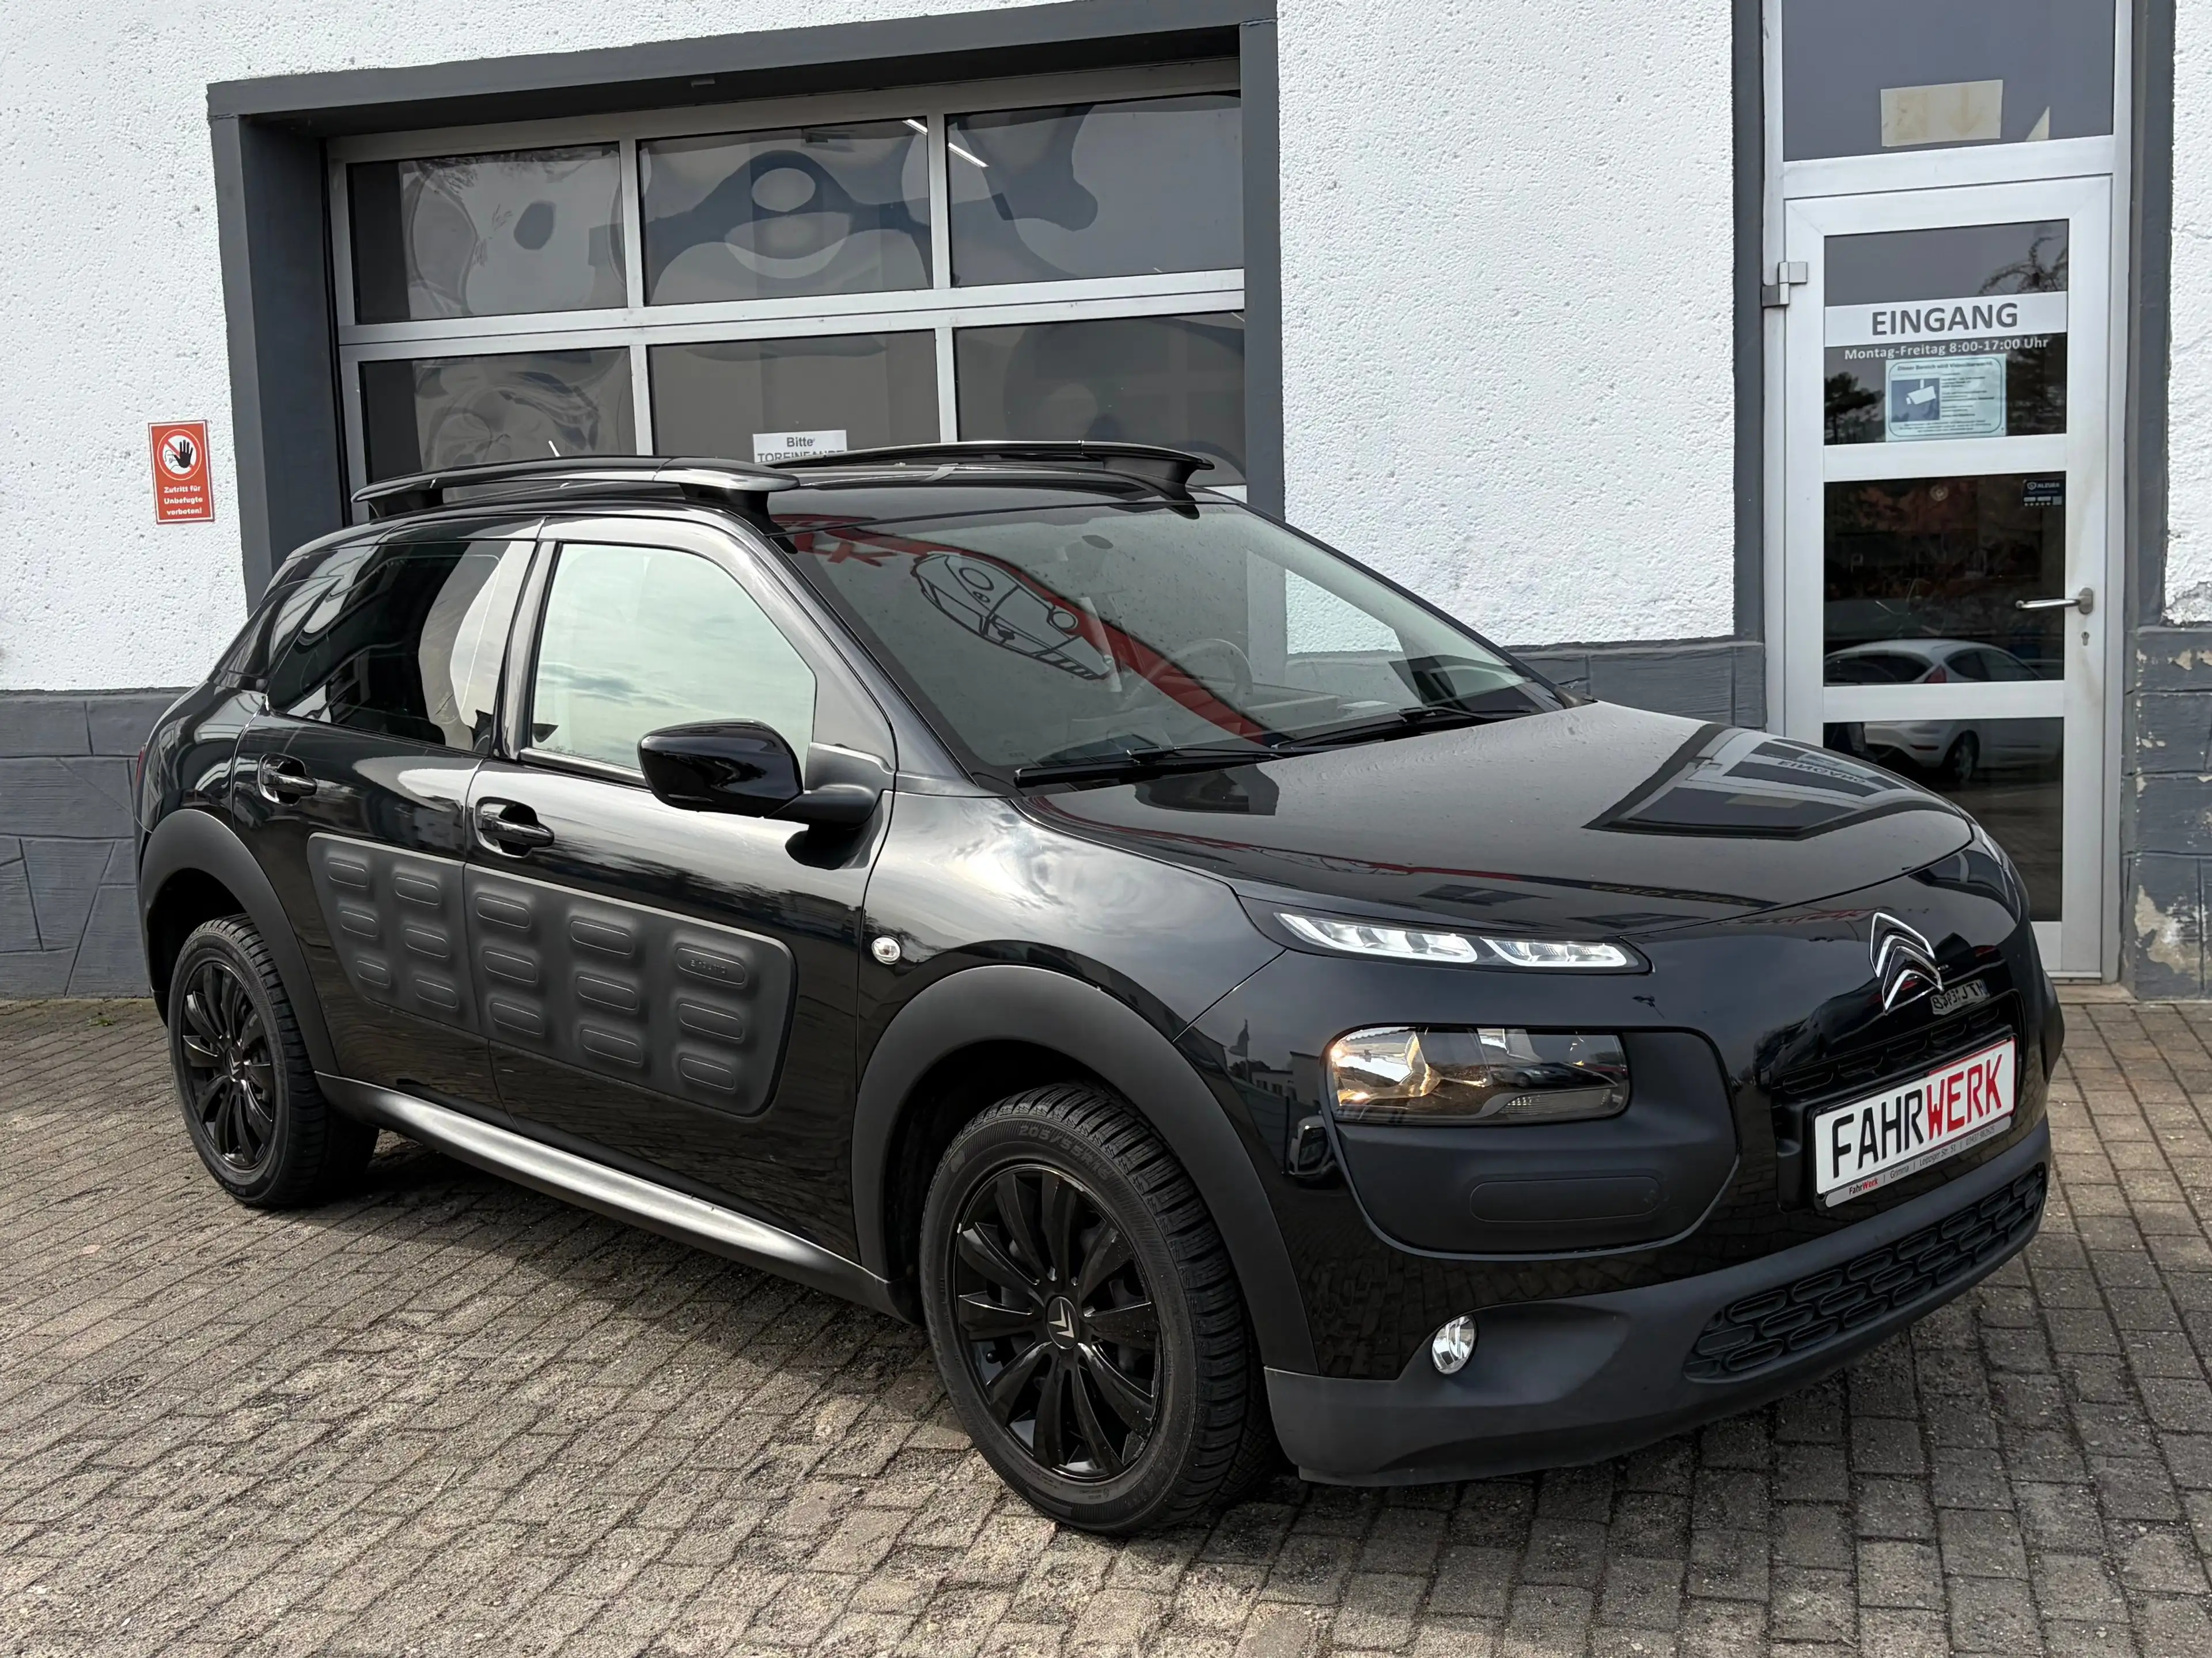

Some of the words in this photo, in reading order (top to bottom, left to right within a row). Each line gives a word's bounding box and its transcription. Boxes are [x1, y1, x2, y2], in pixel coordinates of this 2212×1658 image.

[1872, 302, 2018, 336] EINGANG
[1844, 344, 1946, 360] Montag-Freitag
[1949, 339, 2020, 353] 8:00-17:00
[2023, 337, 2049, 350] Uhr
[787, 437, 814, 447] Bitte
[164, 496, 203, 504] Unbefugte
[166, 507, 202, 515] verboten!
[1832, 1054, 2002, 1179] FAHRWERK
[1849, 1178, 1878, 1195] FahrWerk
